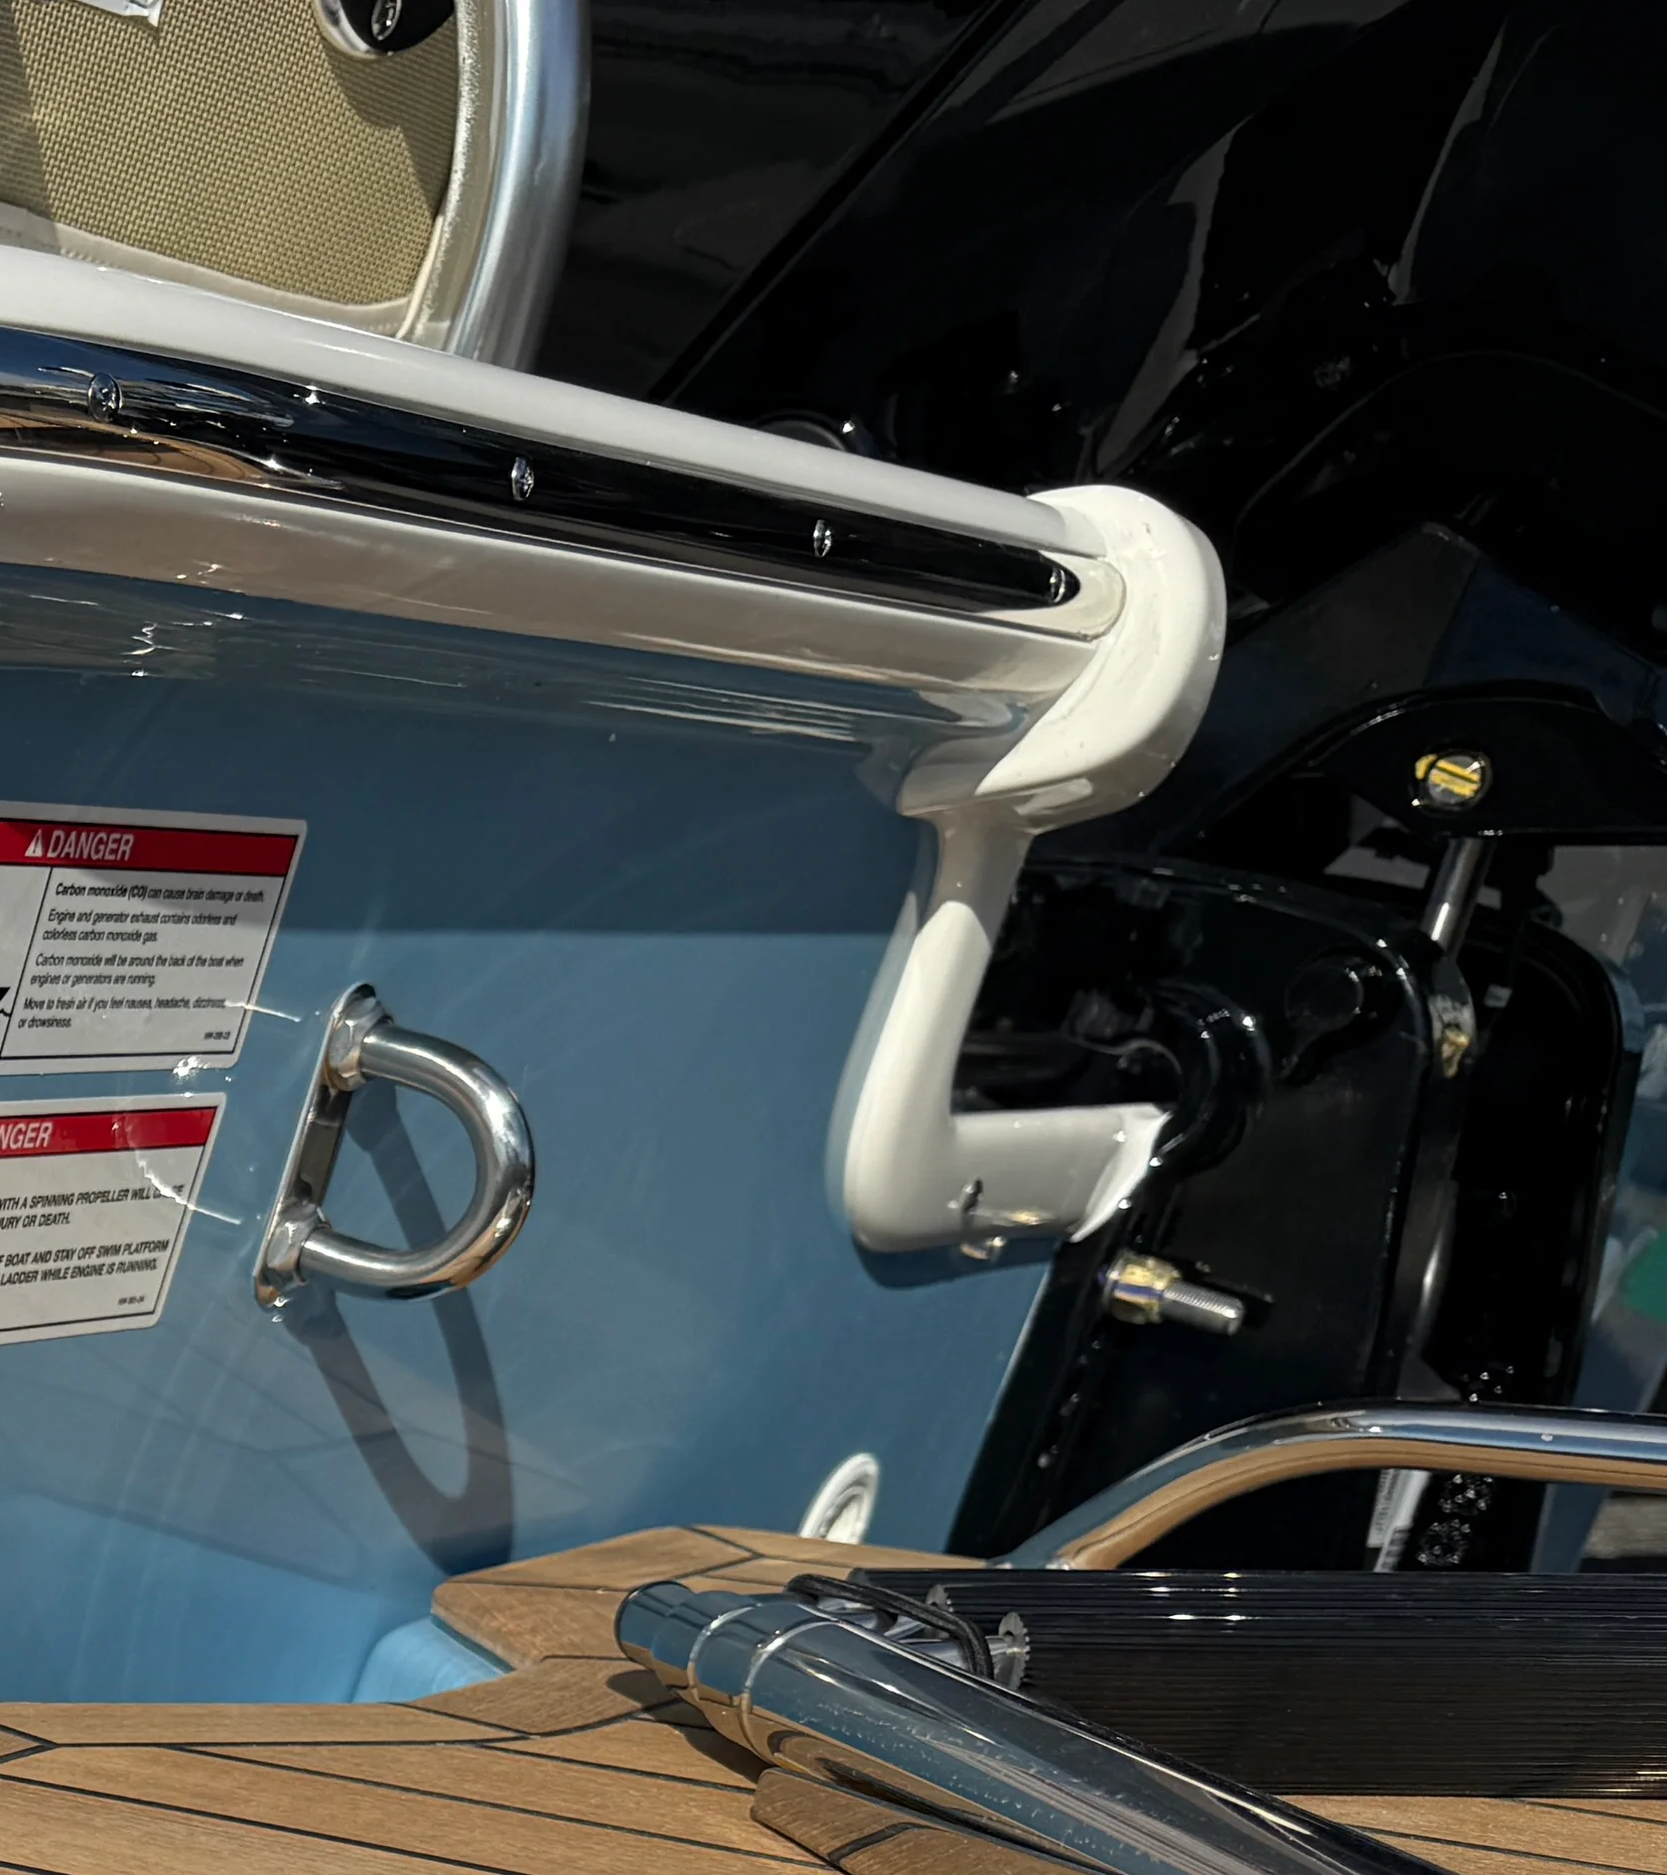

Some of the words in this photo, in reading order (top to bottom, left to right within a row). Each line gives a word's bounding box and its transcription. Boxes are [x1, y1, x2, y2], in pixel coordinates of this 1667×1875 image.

[47, 830, 134, 861] DANGER
[55, 883, 86, 896] Carbon
[87, 885, 127, 897] monoxide
[128, 884, 147, 900] (CO)
[147, 888, 163, 899] can
[162, 889, 186, 899] cause
[185, 888, 206, 900] brain
[205, 889, 234, 903] damage
[234, 891, 244, 902] or
[48, 909, 76, 925] Engine
[77, 910, 93, 922] and
[92, 911, 130, 925] generator
[130, 912, 160, 924] exhaust
[160, 913, 190, 924] contains
[191, 913, 222, 925] odorless
[222, 914, 238, 925] and
[43, 929, 78, 940] colorless
[78, 929, 105, 941] carbon
[106, 930, 142, 941] monoxide
[36, 953, 65, 966] Carbon
[66, 954, 103, 966] monoxide
[103, 954, 117, 966] will
[117, 955, 127, 967] be
[128, 955, 155, 967] around
[155, 955, 168, 967] the
[168, 955, 186, 967] back
[186, 955, 196, 967] of
[195, 955, 208, 967] the
[208, 956, 225, 968] boat
[225, 956, 244, 968] when
[31, 974, 62, 988] engines
[61, 975, 72, 985] or
[70, 974, 113, 988] generators
[113, 975, 128, 985] are
[23, 998, 46, 1010] Move
[46, 999, 56, 1010] to
[55, 998, 76, 1010] fresh
[76, 998, 88, 1010] air
[92, 1000, 109, 1012] you
[109, 998, 126, 1009] feel
[17, 1018, 28, 1029] or
[19, 1197, 28, 1210] A
[29, 1193, 75, 1209] SPINNING
[75, 1189, 130, 1205] PROPELLER
[130, 1187, 150, 1201] WILL
[22, 1214, 37, 1228] OR
[4, 1252, 31, 1268] BOAT
[30, 1250, 53, 1264] AND
[53, 1248, 77, 1263] STAY
[77, 1246, 96, 1261] OFF
[96, 1243, 122, 1258] SWIM
[122, 1239, 170, 1256] PLATFORM
[0, 1270, 39, 1286] LADDER
[40, 1267, 71, 1281] WHILE
[70, 1263, 106, 1279] ENGINE
[105, 1262, 116, 1275] IS
